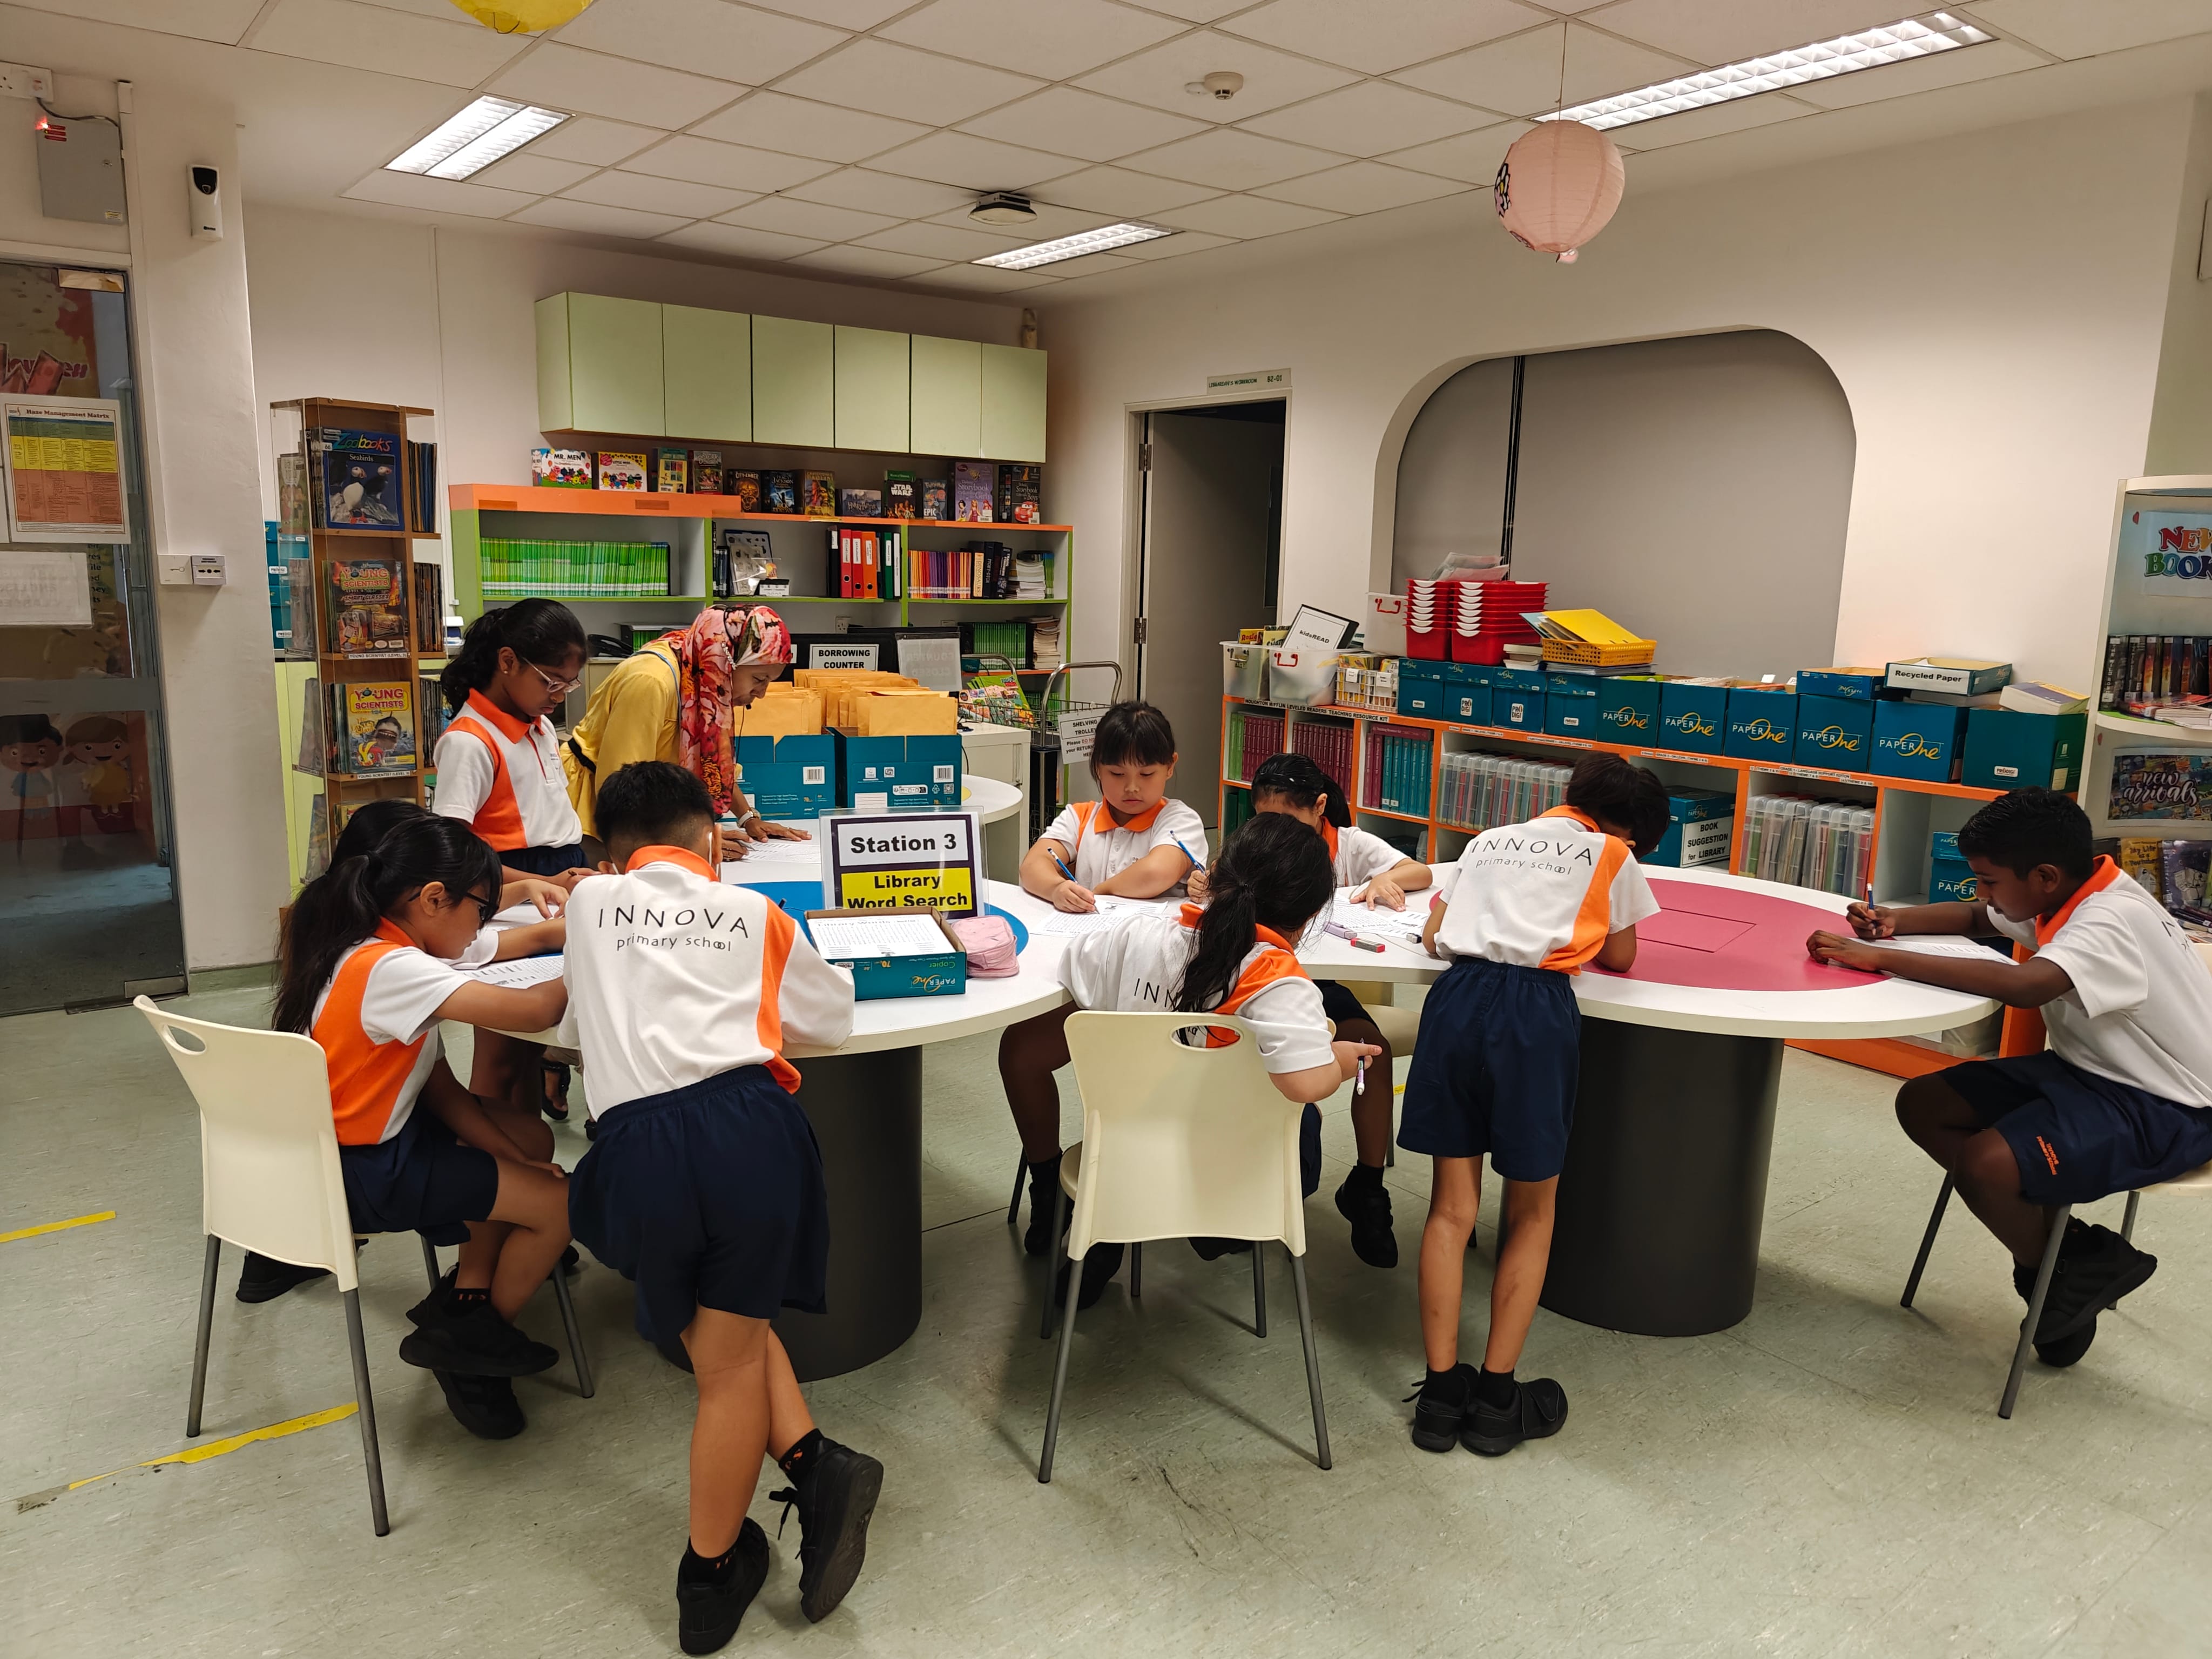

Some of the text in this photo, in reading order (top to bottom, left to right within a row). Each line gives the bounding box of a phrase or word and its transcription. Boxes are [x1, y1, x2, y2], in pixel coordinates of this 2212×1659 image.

[333, 433, 393, 451] Zoobooks
[349, 454, 374, 462] Seabirds
[958, 483, 989, 492] Storybook
[1027, 493, 1038, 501] Boys
[1299, 630, 1330, 644] kidsREAD
[1895, 670, 1962, 683] Recycled Paper
[355, 700, 404, 709] SCIENTISTS
[1073, 719, 1097, 727] SHELVING
[1603, 712, 1630, 722] PAPER
[1665, 718, 1694, 728] PAPER
[1732, 724, 1763, 734] PAPER
[1802, 731, 1835, 743] PAPER
[1879, 739, 1915, 751] PAPER
[2142, 771, 2179, 787] new
[2123, 777, 2198, 807] arrivals
[1700, 821, 1718, 832] BOOK
[851, 833, 956, 853] Station 3
[1687, 833, 1728, 847] SUGGESTION
[1471, 838, 1592, 866] INNOVA
[1698, 846, 1725, 858] LIBRARY
[1475, 857, 1572, 875] primary school
[874, 875, 941, 889] Library
[1938, 882, 1977, 896] PAPER
[847, 893, 967, 908] Word Search
[598, 905, 750, 940] INNOVA
[617, 933, 732, 952] primary school
[929, 978, 955, 986] PAPER
